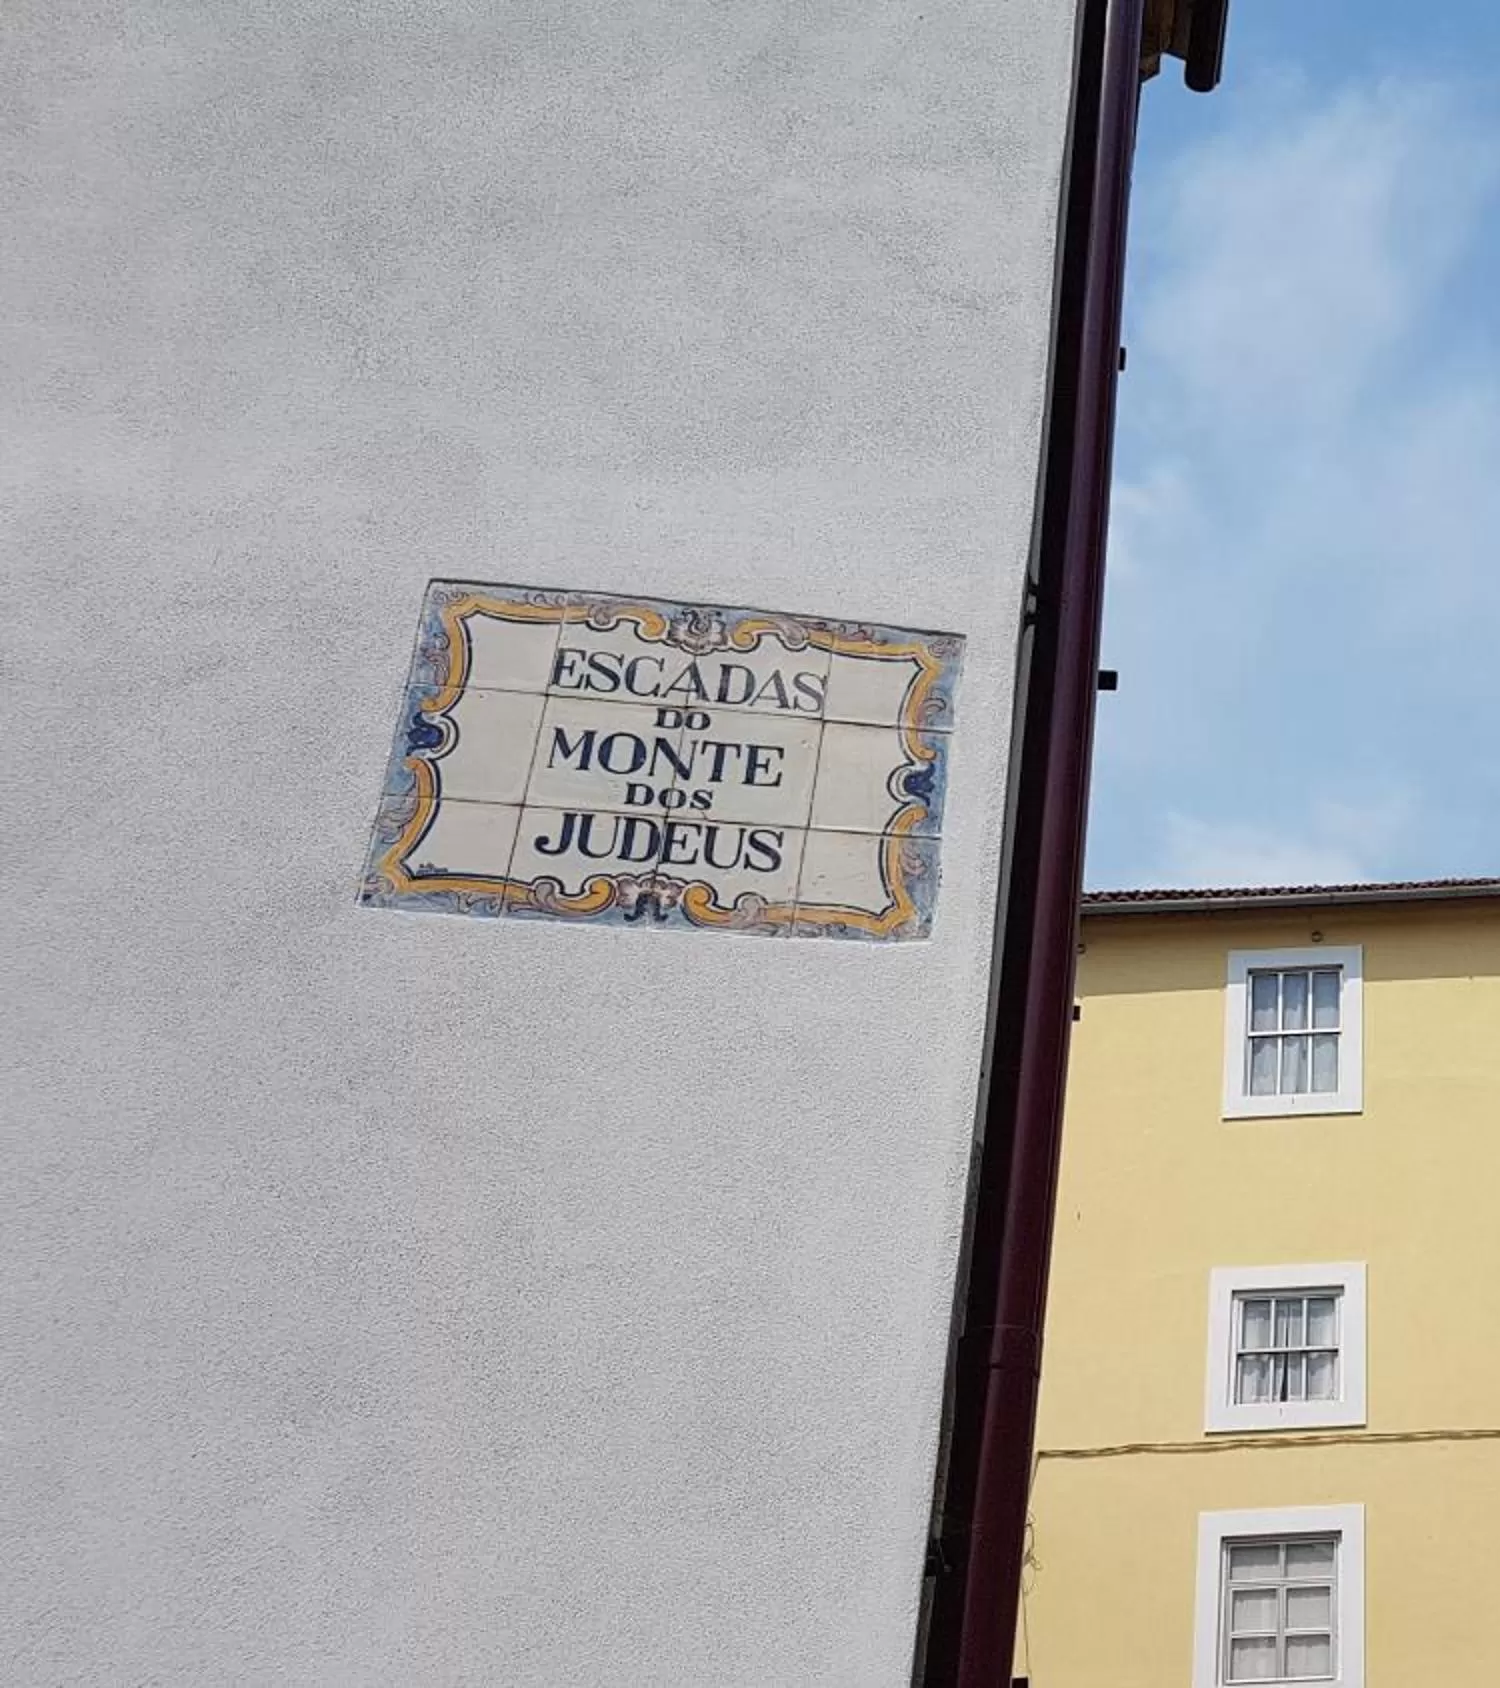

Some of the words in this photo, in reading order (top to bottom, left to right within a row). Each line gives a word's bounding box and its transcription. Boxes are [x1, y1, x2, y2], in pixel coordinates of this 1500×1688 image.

[550, 647, 827, 711] ESCADAS
[653, 707, 712, 731] DO
[547, 727, 784, 787] MONTE
[624, 783, 713, 811] DOS
[534, 812, 784, 873] JUDEUS
